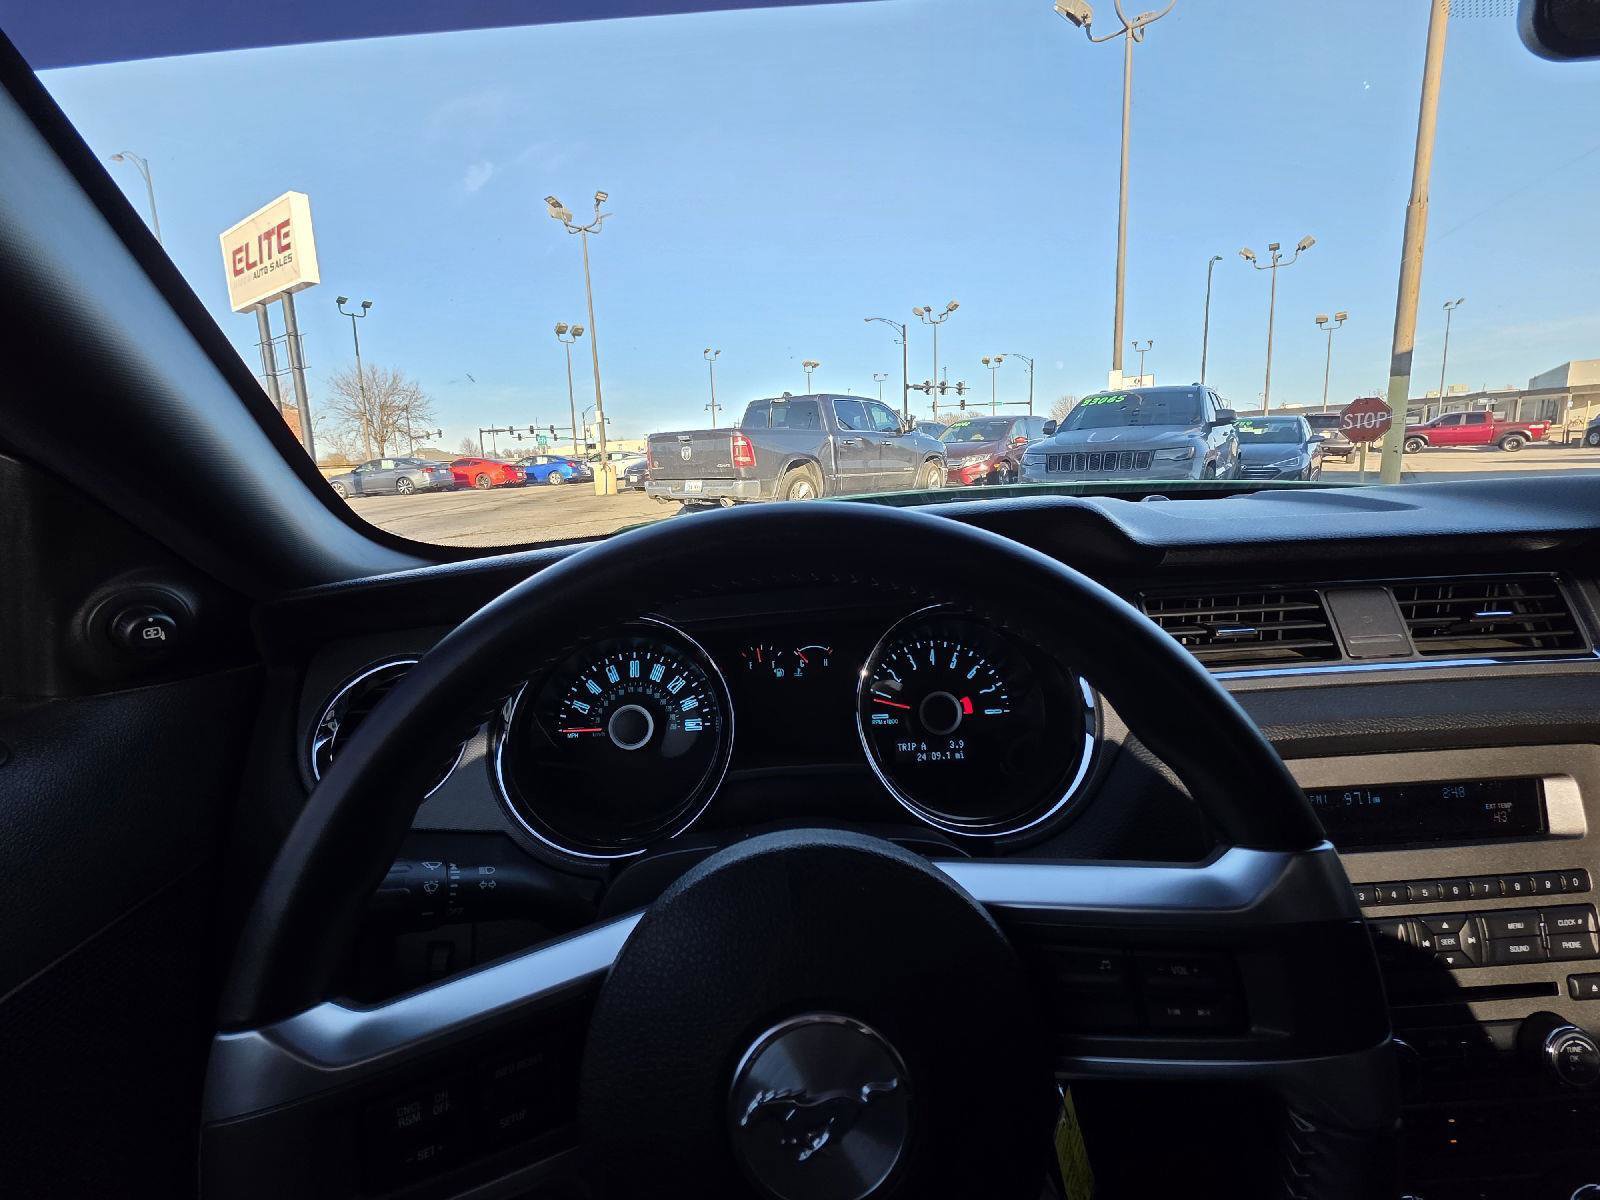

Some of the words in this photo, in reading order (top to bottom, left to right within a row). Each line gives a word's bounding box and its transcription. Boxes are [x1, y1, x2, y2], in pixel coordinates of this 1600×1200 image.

[232, 218, 291, 278] ELITE
[253, 265, 269, 280] AUTO
[269, 253, 293, 272] SALES
[1343, 411, 1387, 429] STOP
[823, 658, 828, 666] H
[929, 649, 935, 665] 4
[606, 665, 620, 683] 60
[629, 660, 639, 678] 80
[650, 663, 665, 683] 100
[586, 679, 602, 695] 40
[667, 675, 685, 694] 120
[572, 700, 590, 714] 20
[680, 695, 698, 711] 140
[684, 718, 702, 731] 160
[898, 743, 916, 752] TRIP
[921, 742, 927, 751] A
[949, 740, 964, 749] 3.9
[954, 750, 965, 759] mi
[1545, 880, 1551, 888] 9
[1573, 878, 1579, 886] 0
[1359, 892, 1365, 900] 3
[1391, 891, 1397, 899] 4
[1422, 889, 1428, 897] 5
[1507, 922, 1525, 930] MENU
[1557, 919, 1576, 927] CLOCK
[1440, 938, 1456, 946] SEEK
[1562, 940, 1582, 949] PHONE
[1509, 945, 1530, 953] SOUND
